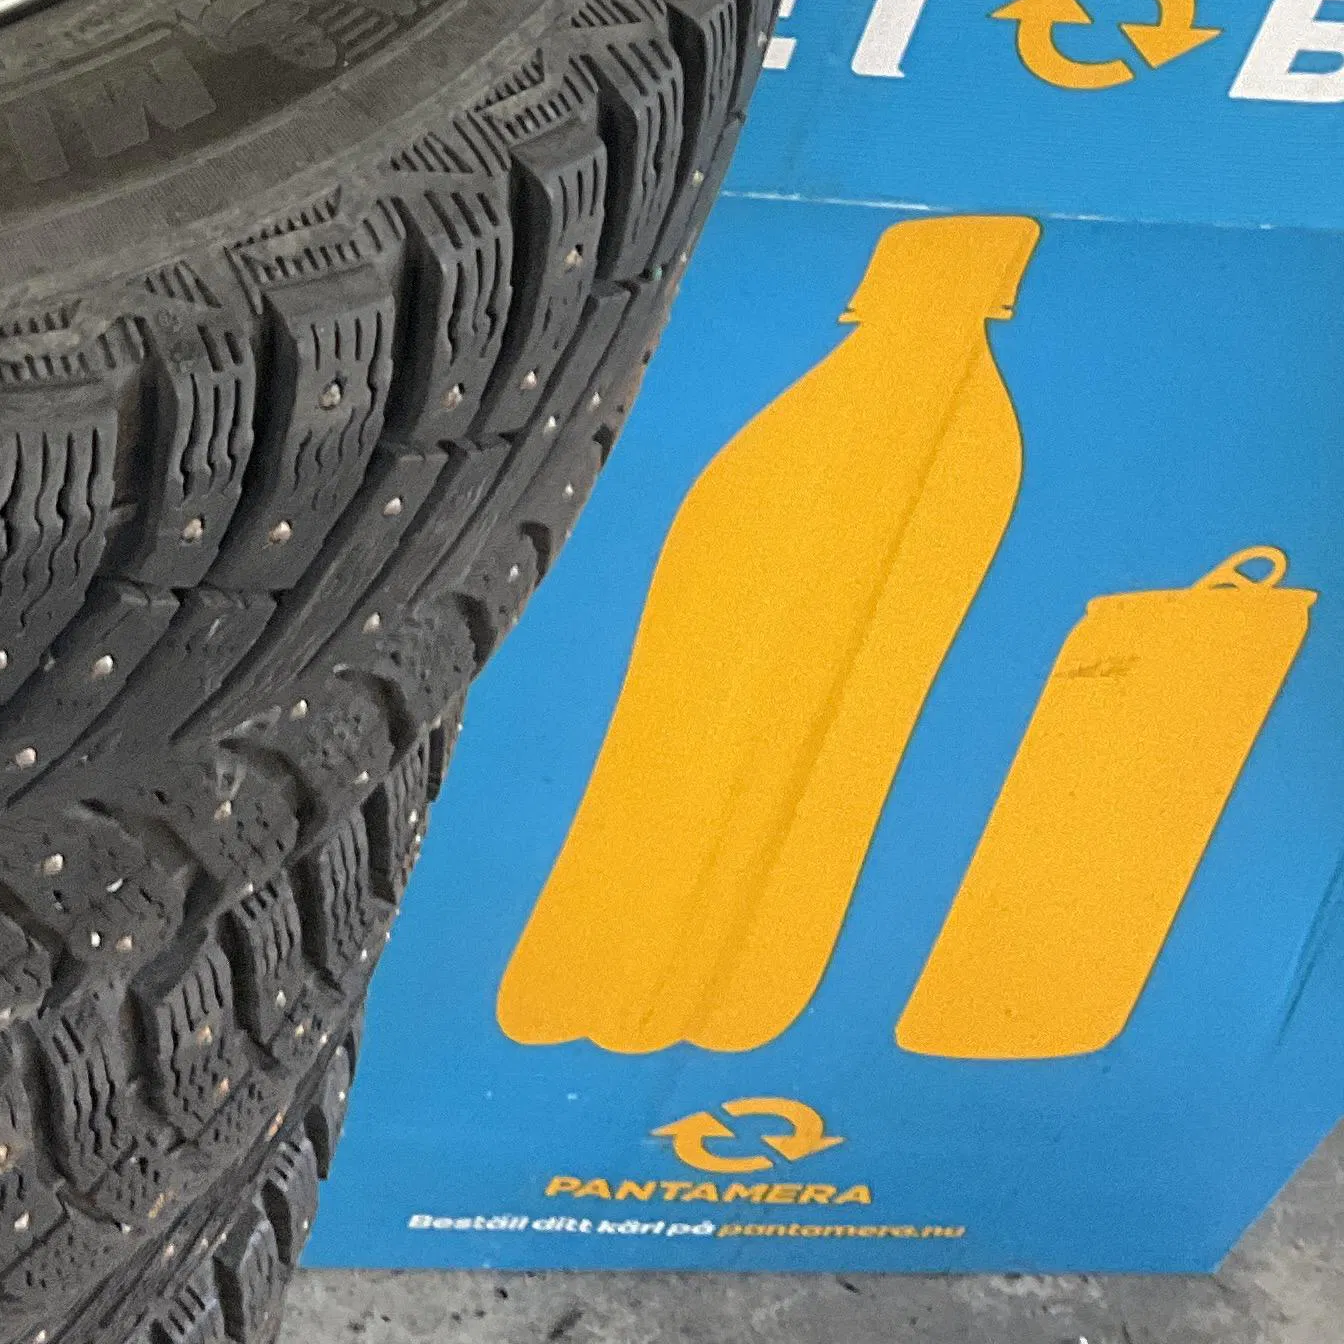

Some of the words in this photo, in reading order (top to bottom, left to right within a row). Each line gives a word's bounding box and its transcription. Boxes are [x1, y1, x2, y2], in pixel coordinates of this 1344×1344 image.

[545, 1176, 873, 1204] PANTAMERA
[409, 1212, 528, 1232] Beställ
[532, 1214, 593, 1234] ditt
[665, 1219, 716, 1238] på
[716, 1221, 966, 1240] pantamera.nu
